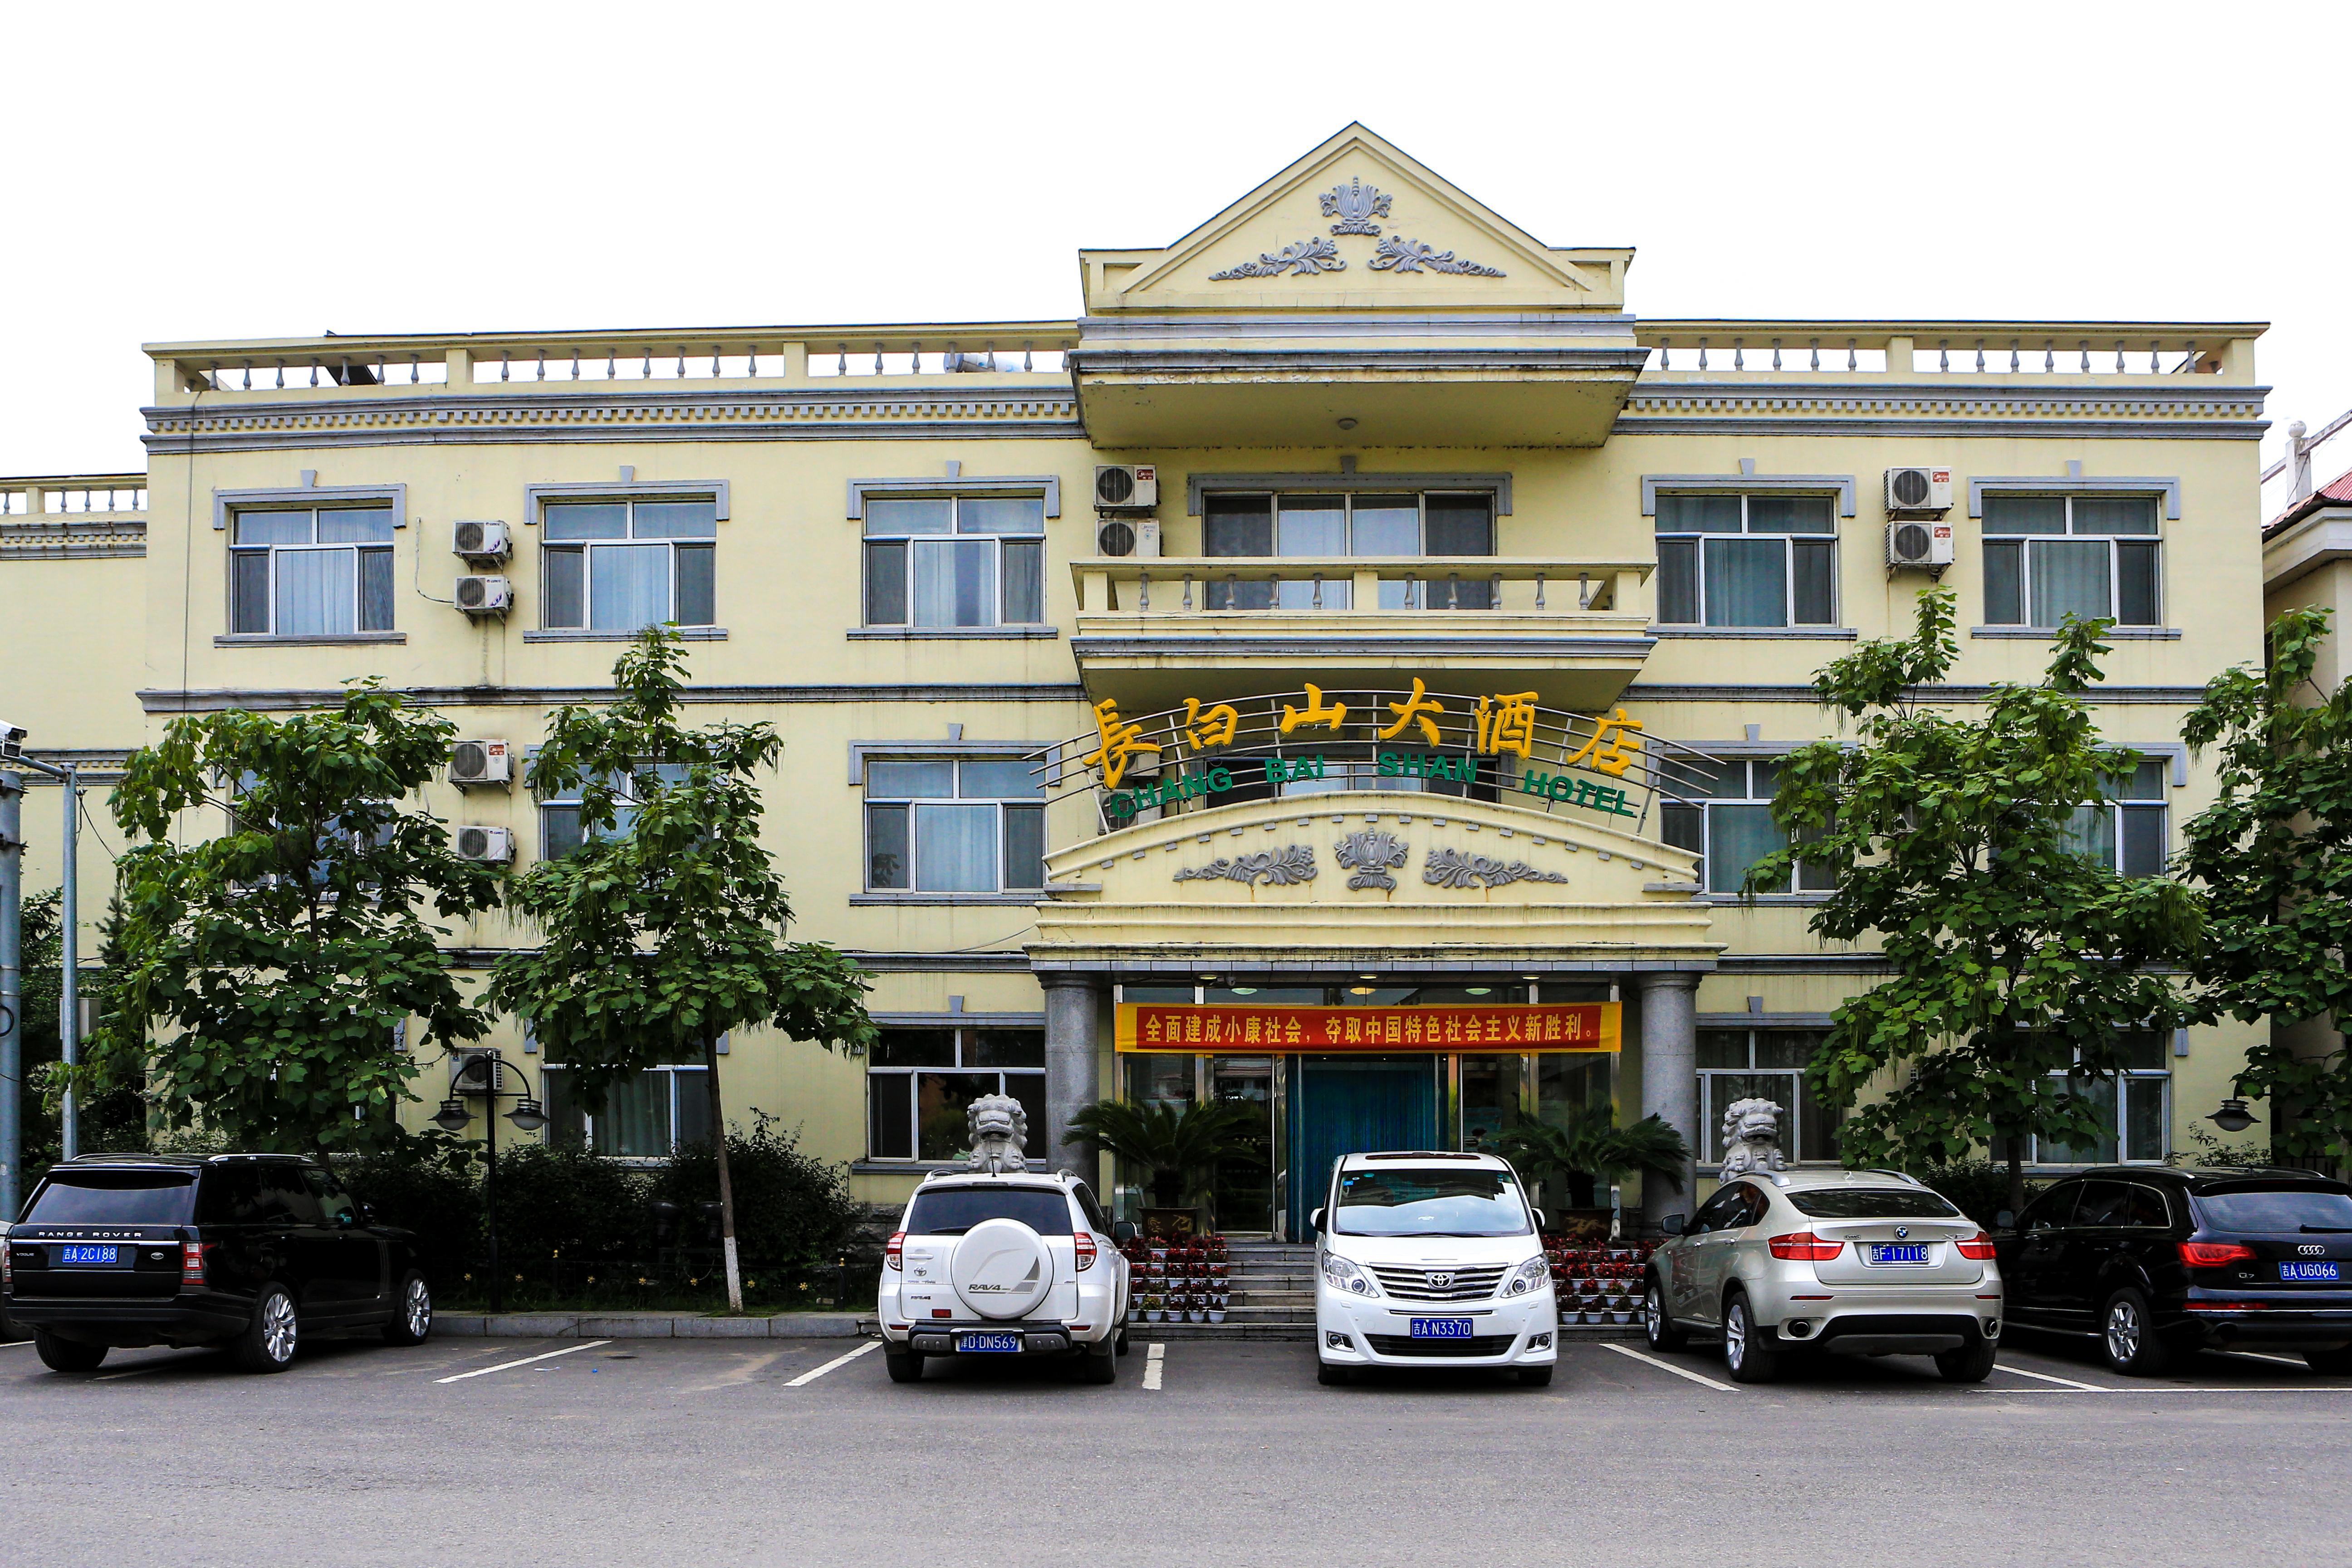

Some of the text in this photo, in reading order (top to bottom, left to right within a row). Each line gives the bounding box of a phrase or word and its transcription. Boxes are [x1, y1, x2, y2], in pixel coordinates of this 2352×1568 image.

[1111, 751, 1637, 818] CHANG BAI SHAN HOTEL
